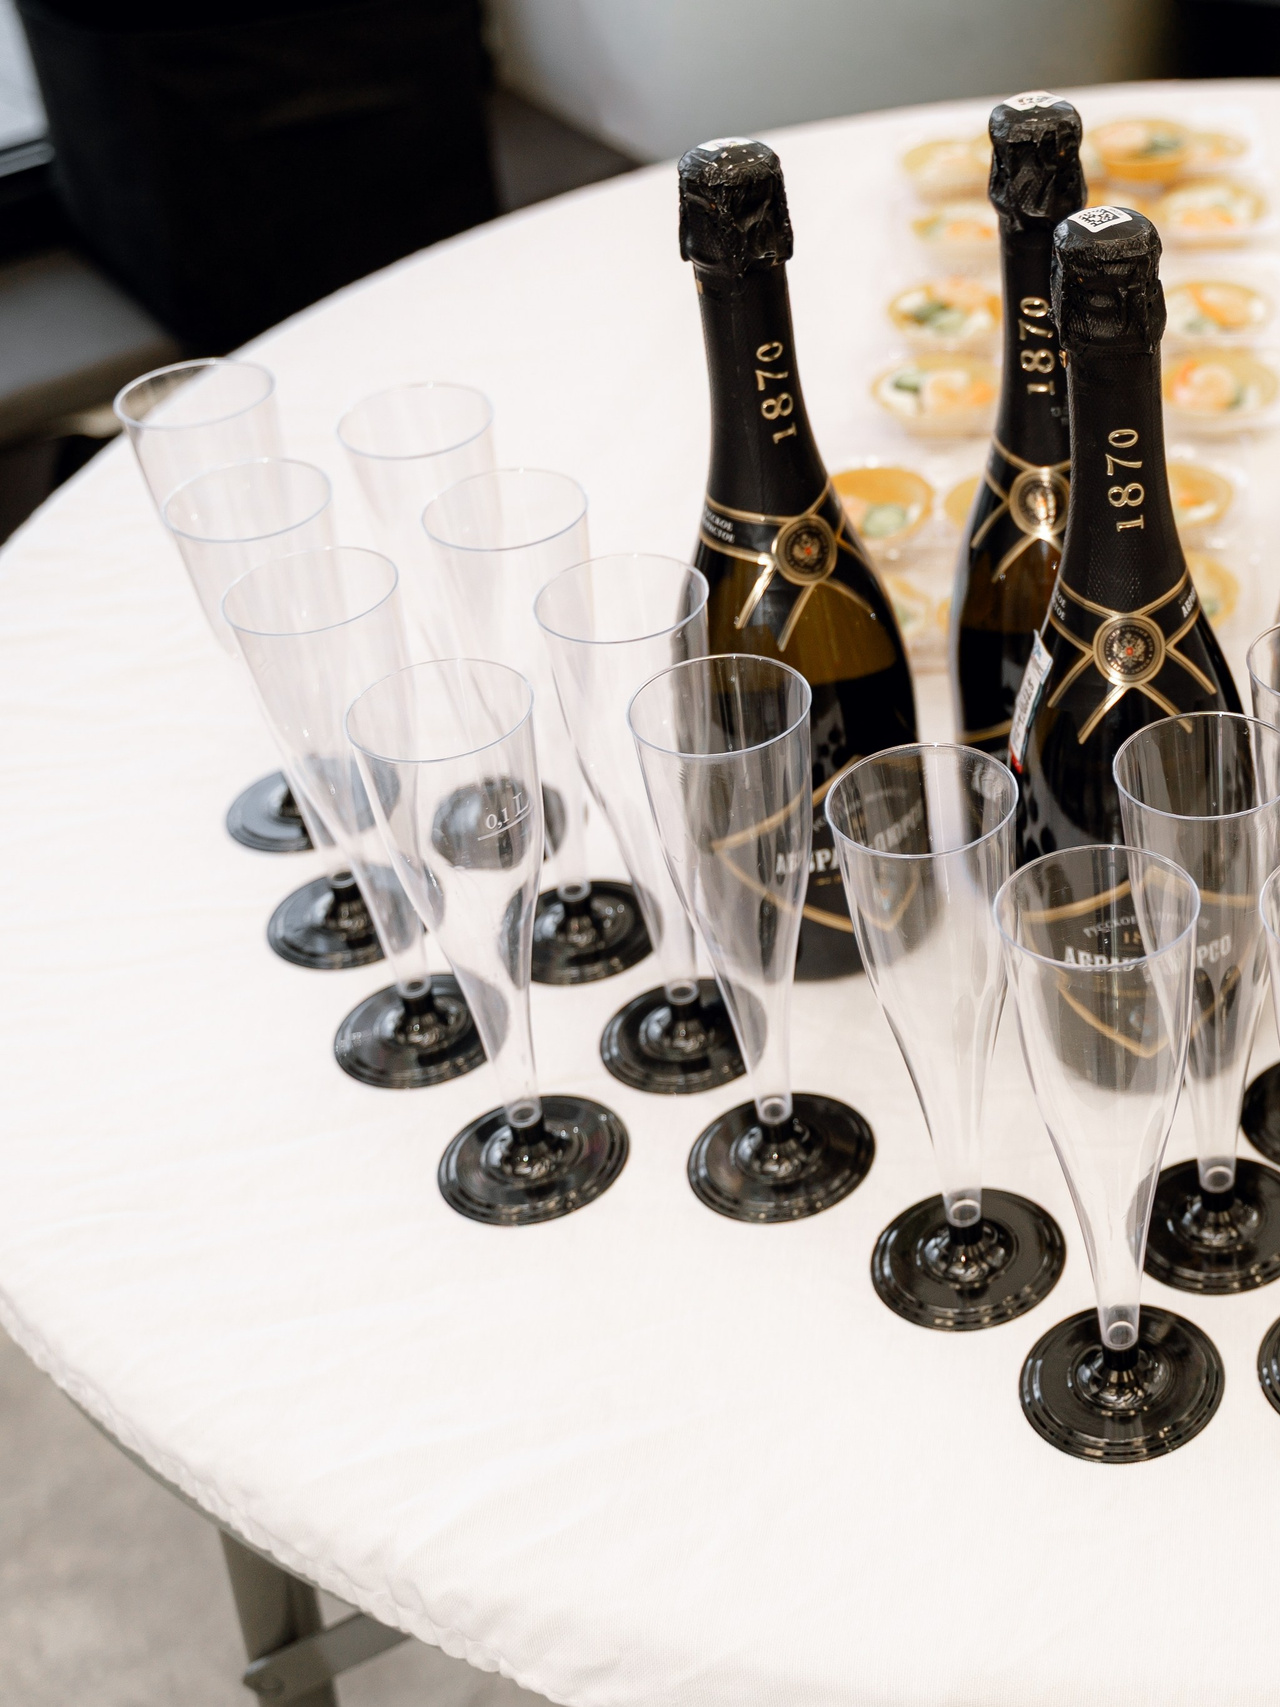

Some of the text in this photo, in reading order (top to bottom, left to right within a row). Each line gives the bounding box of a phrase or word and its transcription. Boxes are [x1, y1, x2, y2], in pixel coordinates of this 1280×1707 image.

[755, 341, 797, 444] 1870
[1017, 296, 1056, 396] 1870
[1105, 428, 1145, 533] 1870
